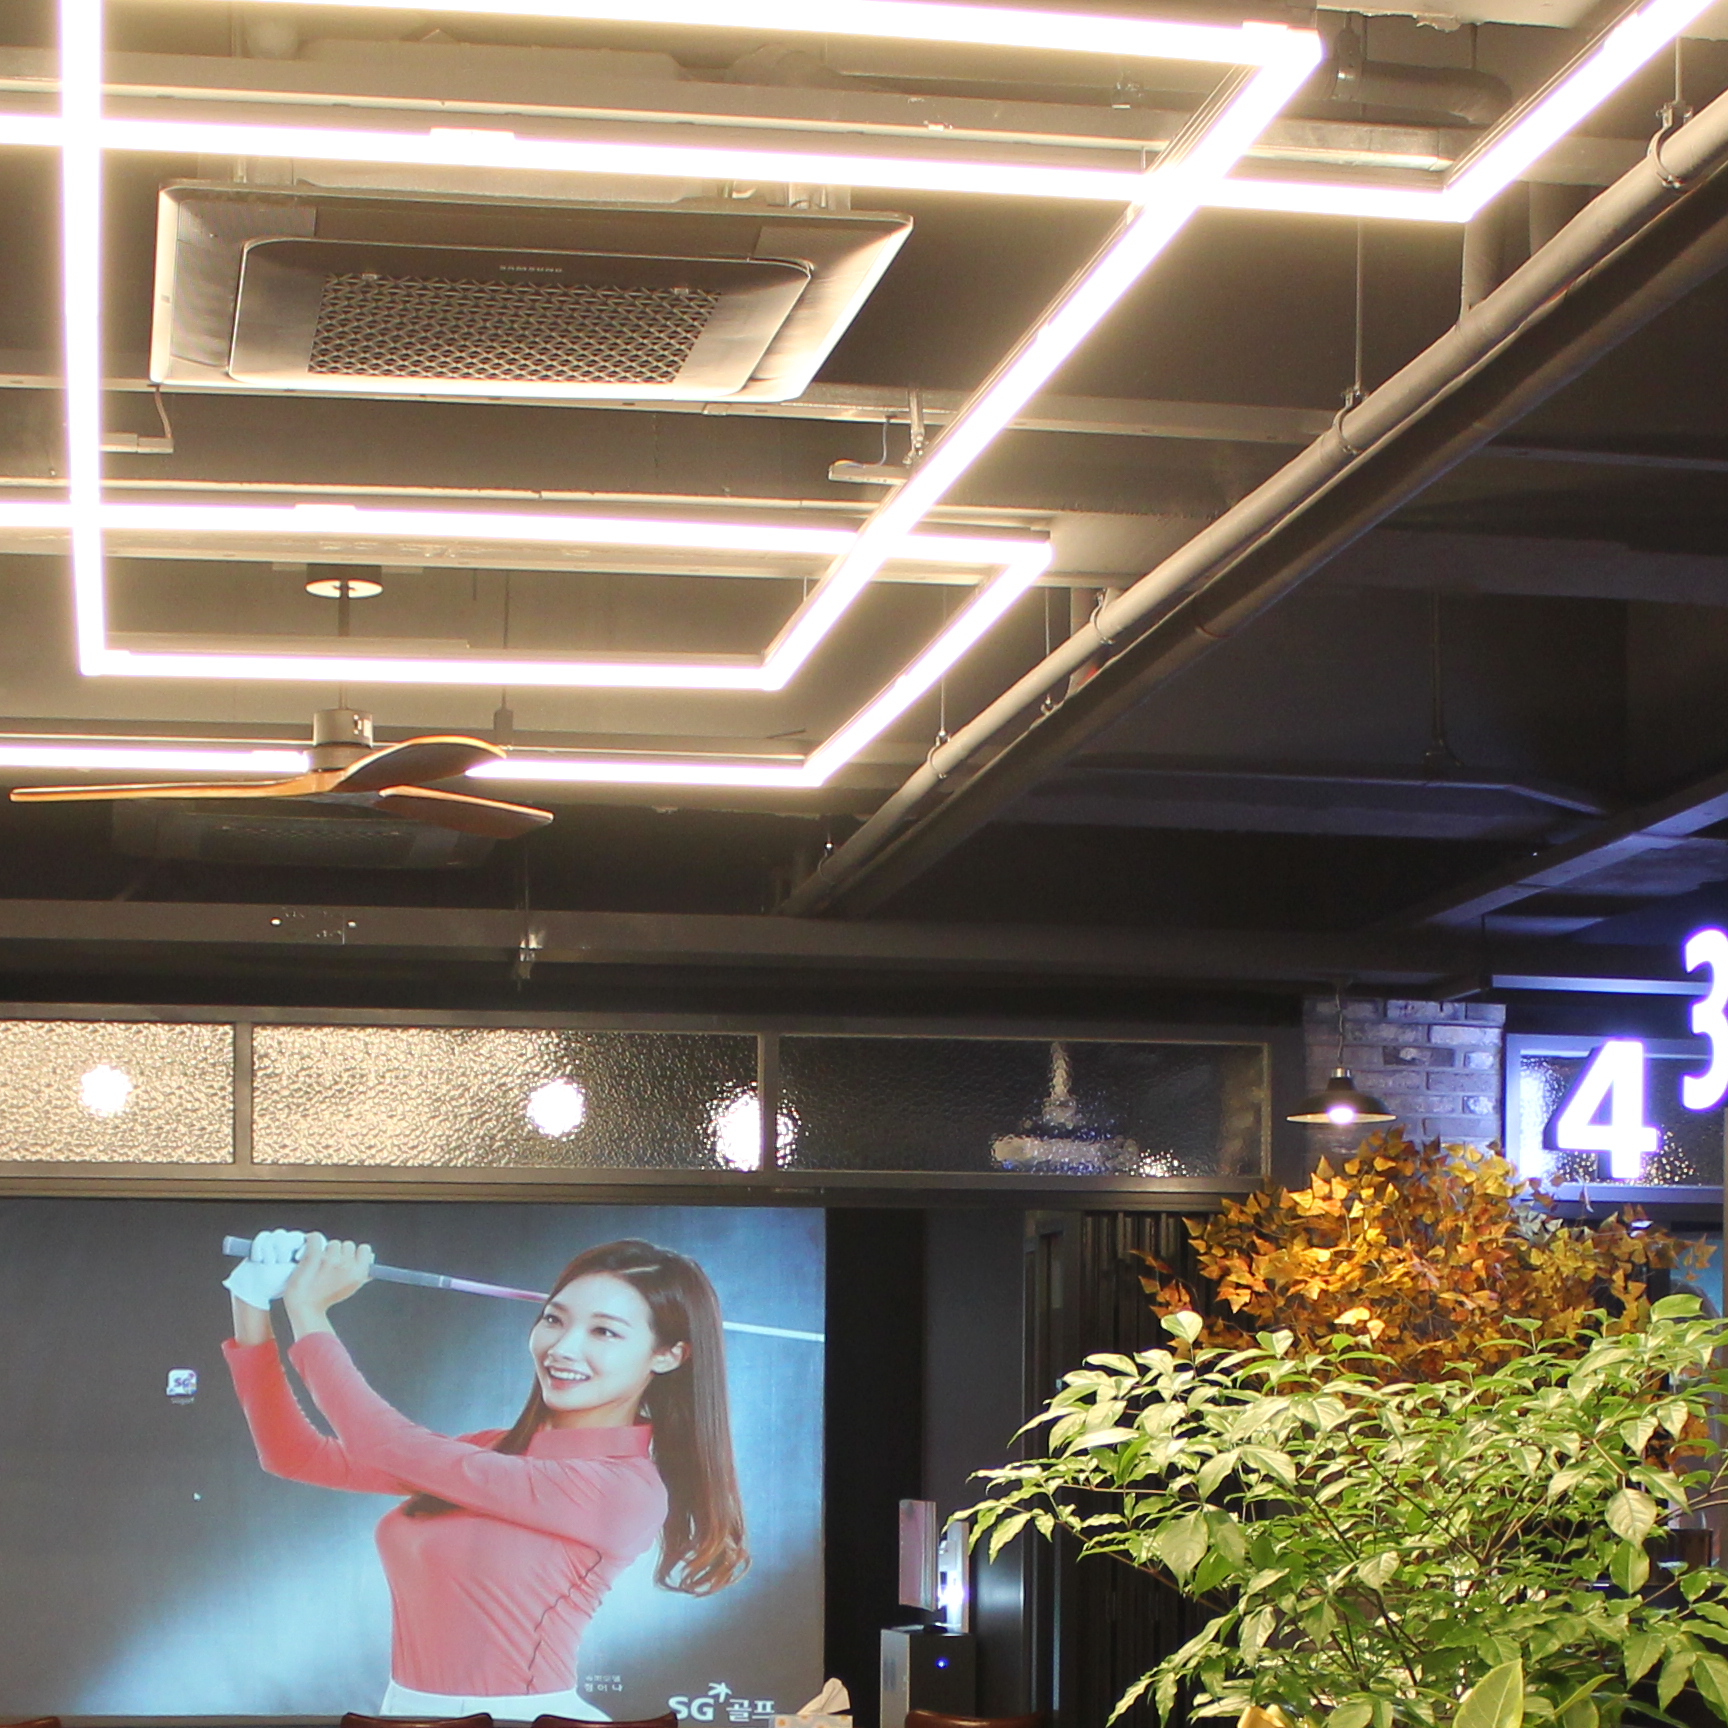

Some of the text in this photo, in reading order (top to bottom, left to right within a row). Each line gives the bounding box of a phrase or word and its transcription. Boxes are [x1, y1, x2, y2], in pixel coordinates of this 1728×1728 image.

[1555, 1039, 1661, 1180] 4
[668, 1696, 775, 1722] SG 골프
